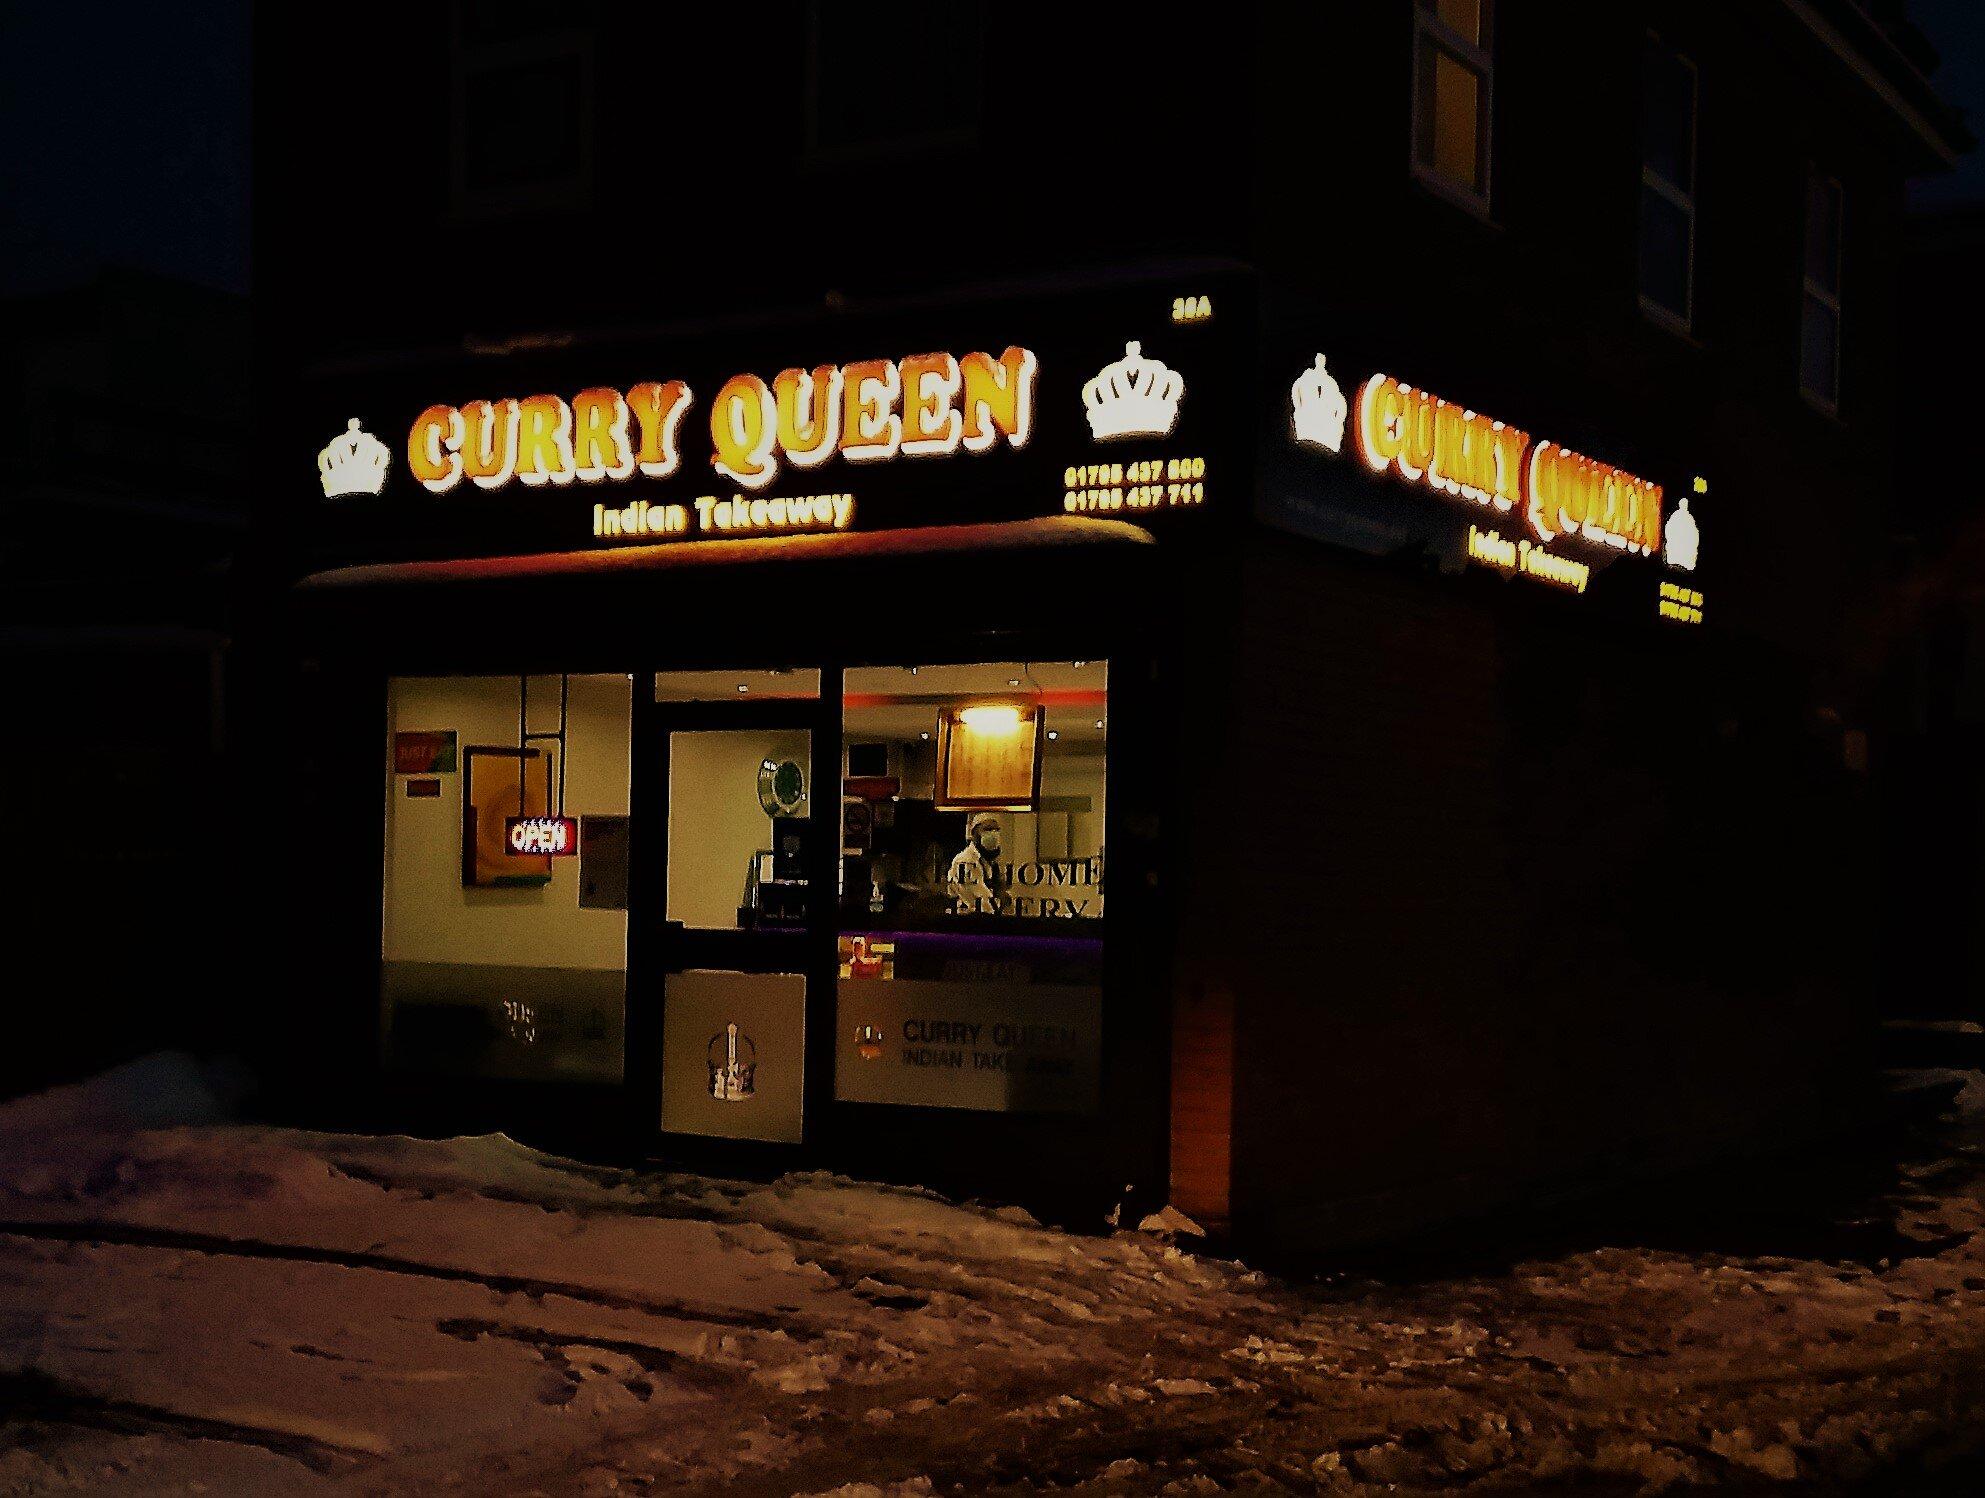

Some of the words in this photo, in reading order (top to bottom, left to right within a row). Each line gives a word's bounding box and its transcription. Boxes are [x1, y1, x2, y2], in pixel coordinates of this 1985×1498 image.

[407, 380, 693, 493] CURRY
[710, 345, 1038, 489] QUEEN
[1126, 460, 1164, 483] 437
[1126, 485, 1164, 508] 437
[1168, 482, 1204, 505] 711
[593, 502, 689, 537] Indian
[694, 493, 855, 531] Takeaway
[511, 818, 567, 853] OPEN
[902, 1019, 981, 1044] CURRY
[902, 1049, 963, 1068] INDIAN
